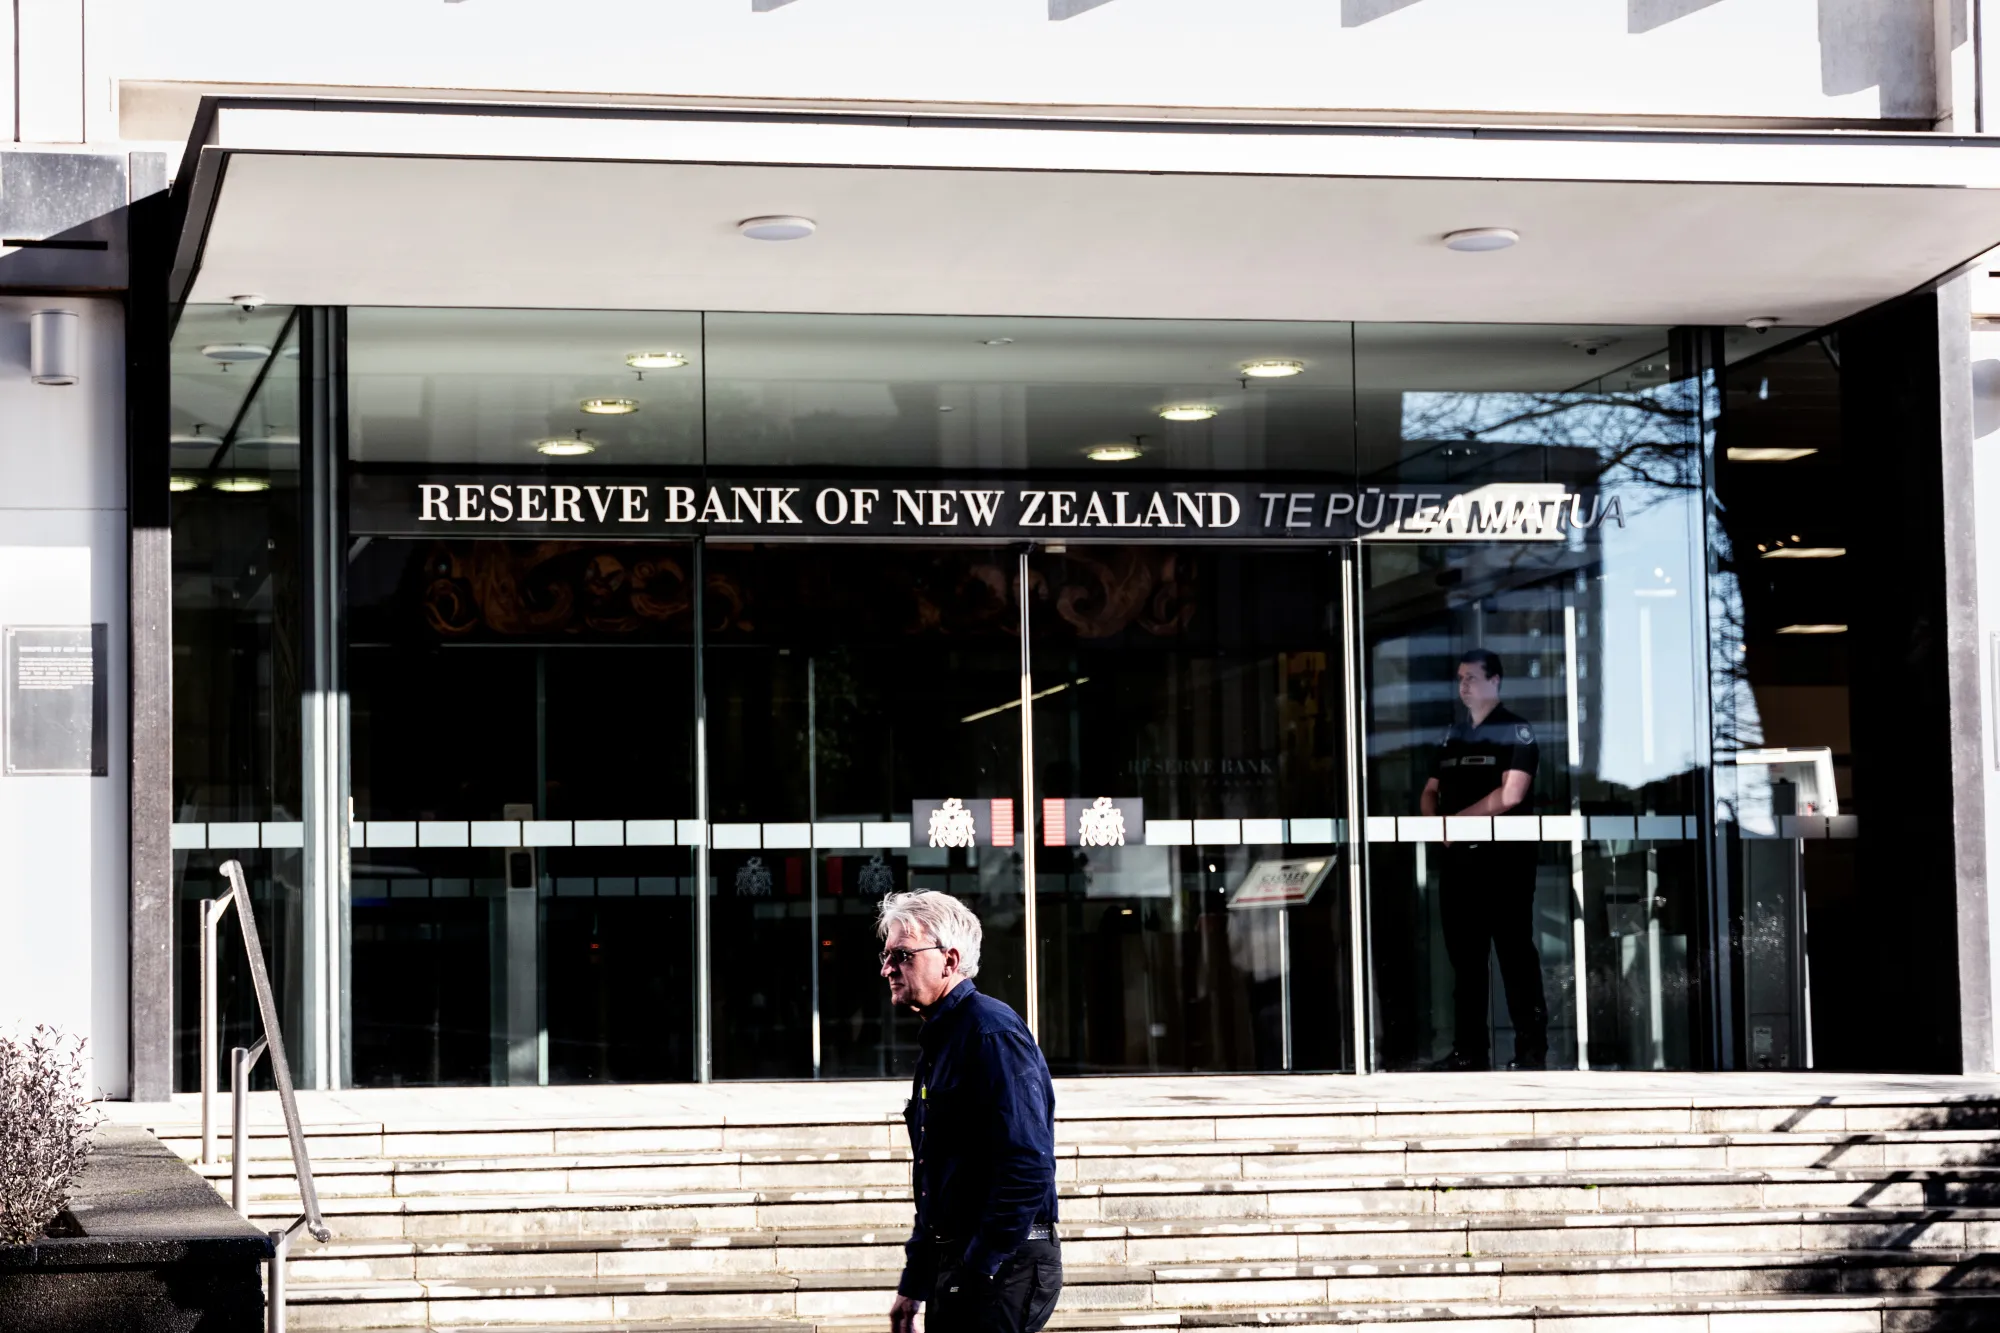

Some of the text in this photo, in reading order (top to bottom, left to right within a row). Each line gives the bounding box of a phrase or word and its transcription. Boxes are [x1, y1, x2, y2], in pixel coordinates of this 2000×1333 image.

[418, 484, 650, 523] RESERVE
[664, 486, 803, 524] BANK
[815, 487, 880, 525] OF
[892, 489, 1005, 527] NEW
[1018, 491, 1241, 528] ZEALAND
[1259, 492, 1316, 528] TE
[1480, 493, 1627, 529] MATUA
[1128, 758, 1273, 775] RESERVE BANK
